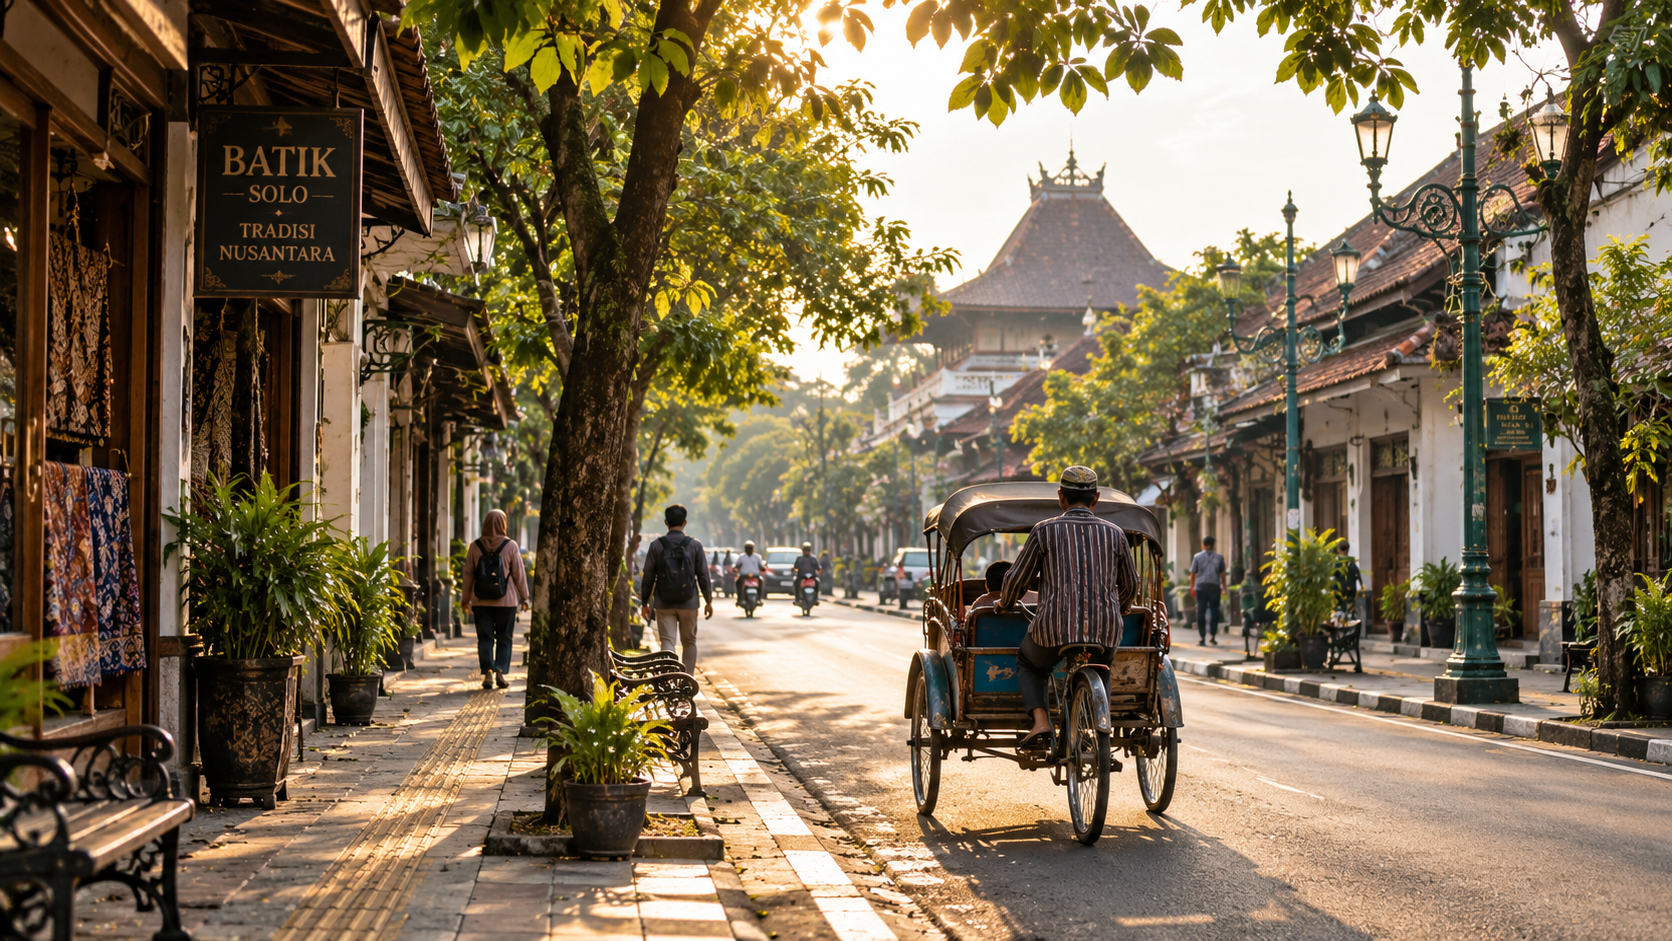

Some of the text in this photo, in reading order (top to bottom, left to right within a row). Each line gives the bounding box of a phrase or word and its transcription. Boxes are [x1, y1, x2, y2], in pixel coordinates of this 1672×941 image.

[222, 145, 337, 178] BATIK
[248, 184, 309, 204] SOLO
[239, 222, 316, 240] TRADISI
[219, 244, 336, 262] NUSANTARA
